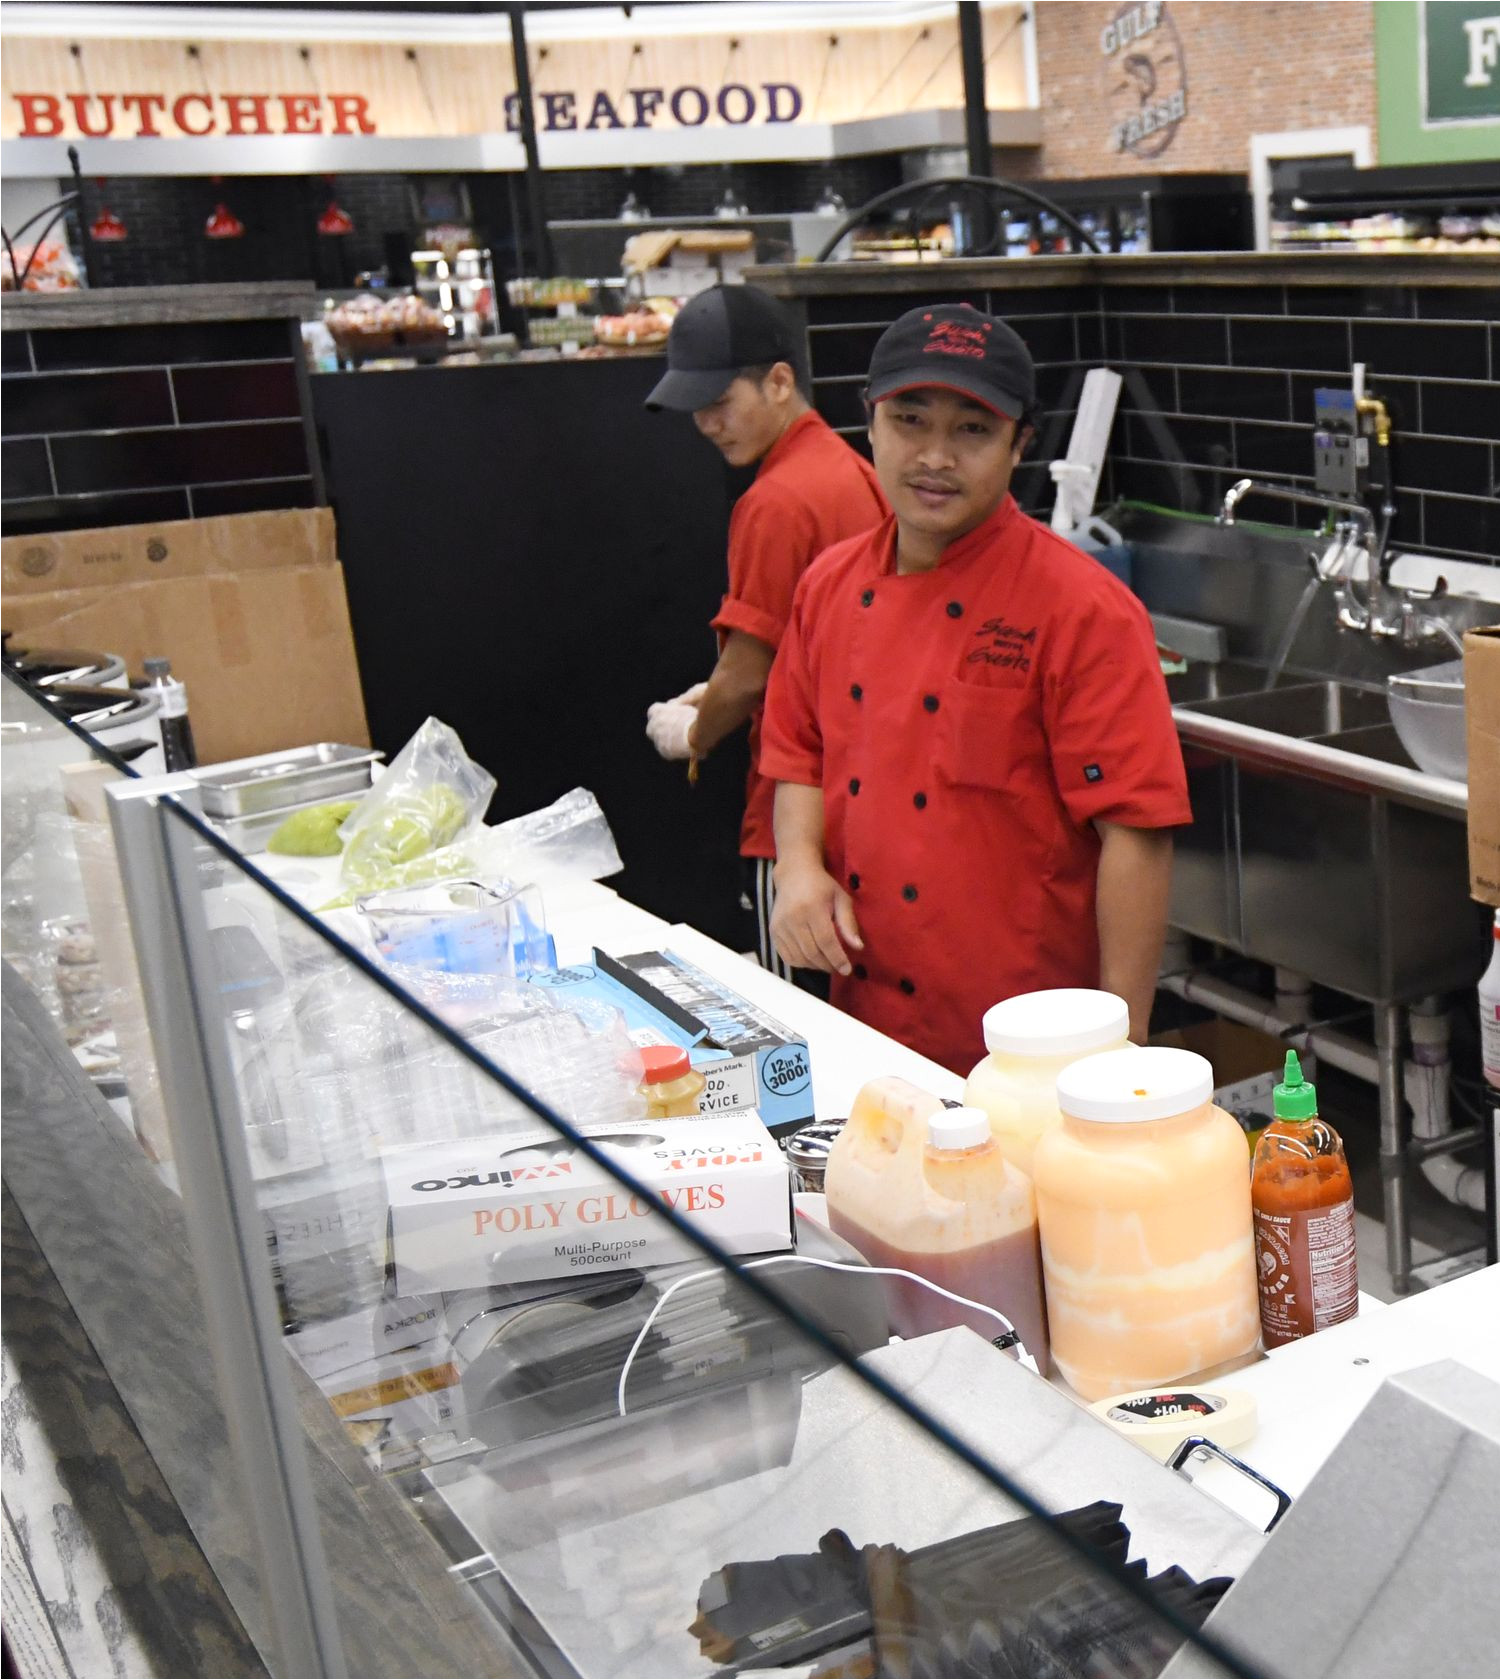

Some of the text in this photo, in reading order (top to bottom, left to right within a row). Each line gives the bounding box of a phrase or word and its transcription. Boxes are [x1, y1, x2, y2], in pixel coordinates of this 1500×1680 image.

[12, 93, 378, 139] BUTCHER
[503, 83, 803, 133] SEAFOOD
[770, 1057, 794, 1075] 12in
[664, 1151, 763, 1171] POLY
[473, 1183, 726, 1236] POLY GLOVES
[554, 1238, 647, 1258] Multi-Purpose
[569, 1251, 632, 1267] 500count
[1154, 1404, 1183, 1416] 101+
